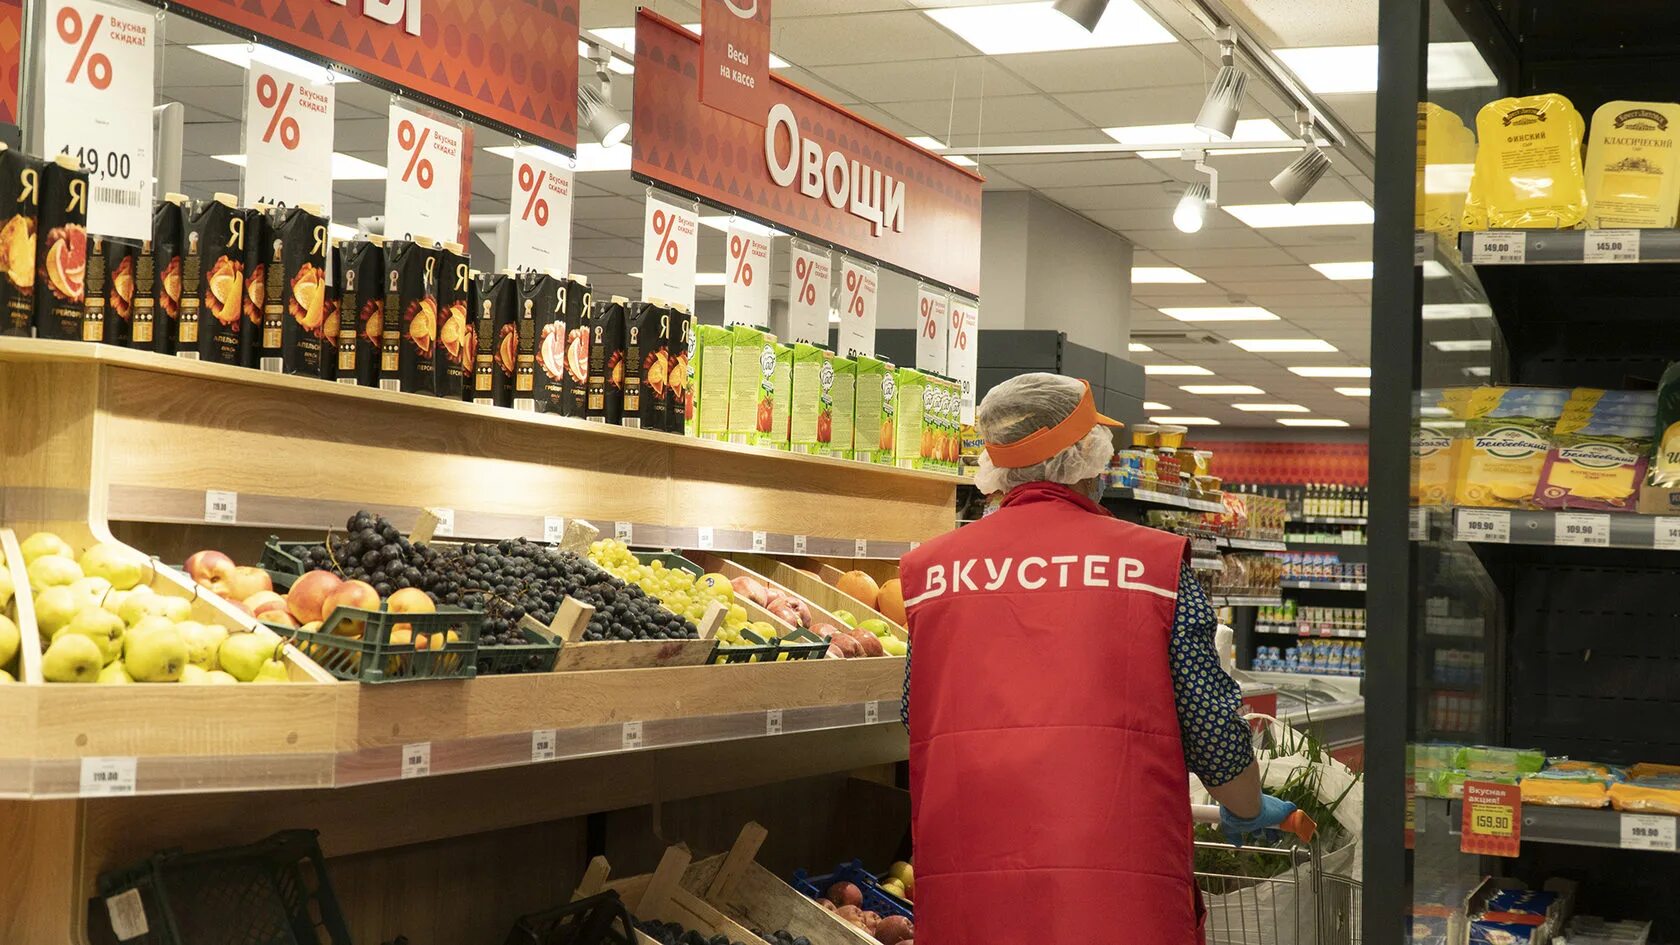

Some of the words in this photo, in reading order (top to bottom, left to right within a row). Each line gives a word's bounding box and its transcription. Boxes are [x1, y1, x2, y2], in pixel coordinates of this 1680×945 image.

[110, 17, 147, 34] Вкусная
[110, 31, 146, 46] скидка!
[727, 43, 749, 66] Весы
[720, 64, 731, 79] на
[732, 69, 755, 89] кассе
[299, 86, 329, 103] Вкусная
[298, 99, 328, 114] скидка!
[434, 131, 456, 146] Вкусная
[1507, 131, 1546, 143] ФИНСКИЙ
[1604, 136, 1673, 148] КЛАССИЧЕСКИЙ
[433, 142, 456, 157] скидка!
[765, 103, 905, 237] Овощи
[17, 168, 38, 206] Я
[549, 173, 569, 188] Вкусная
[65, 179, 86, 215] Я
[548, 184, 568, 196] скидка!
[226, 217, 244, 250] Я
[310, 225, 327, 257] Я
[424, 256, 436, 286] Я
[454, 263, 468, 293] Я
[554, 286, 567, 314] Я
[581, 292, 591, 319] Я
[659, 315, 670, 339] Я
[681, 319, 689, 343] Я
[1476, 437, 1547, 450] Белебеевский
[1561, 449, 1634, 463] Белебеевский
[905, 554, 1176, 607] ВКУСТЕР
[1468, 786, 1506, 796] Вкусная
[1468, 796, 1500, 804] акция!
[1477, 815, 1508, 829] 159,90
